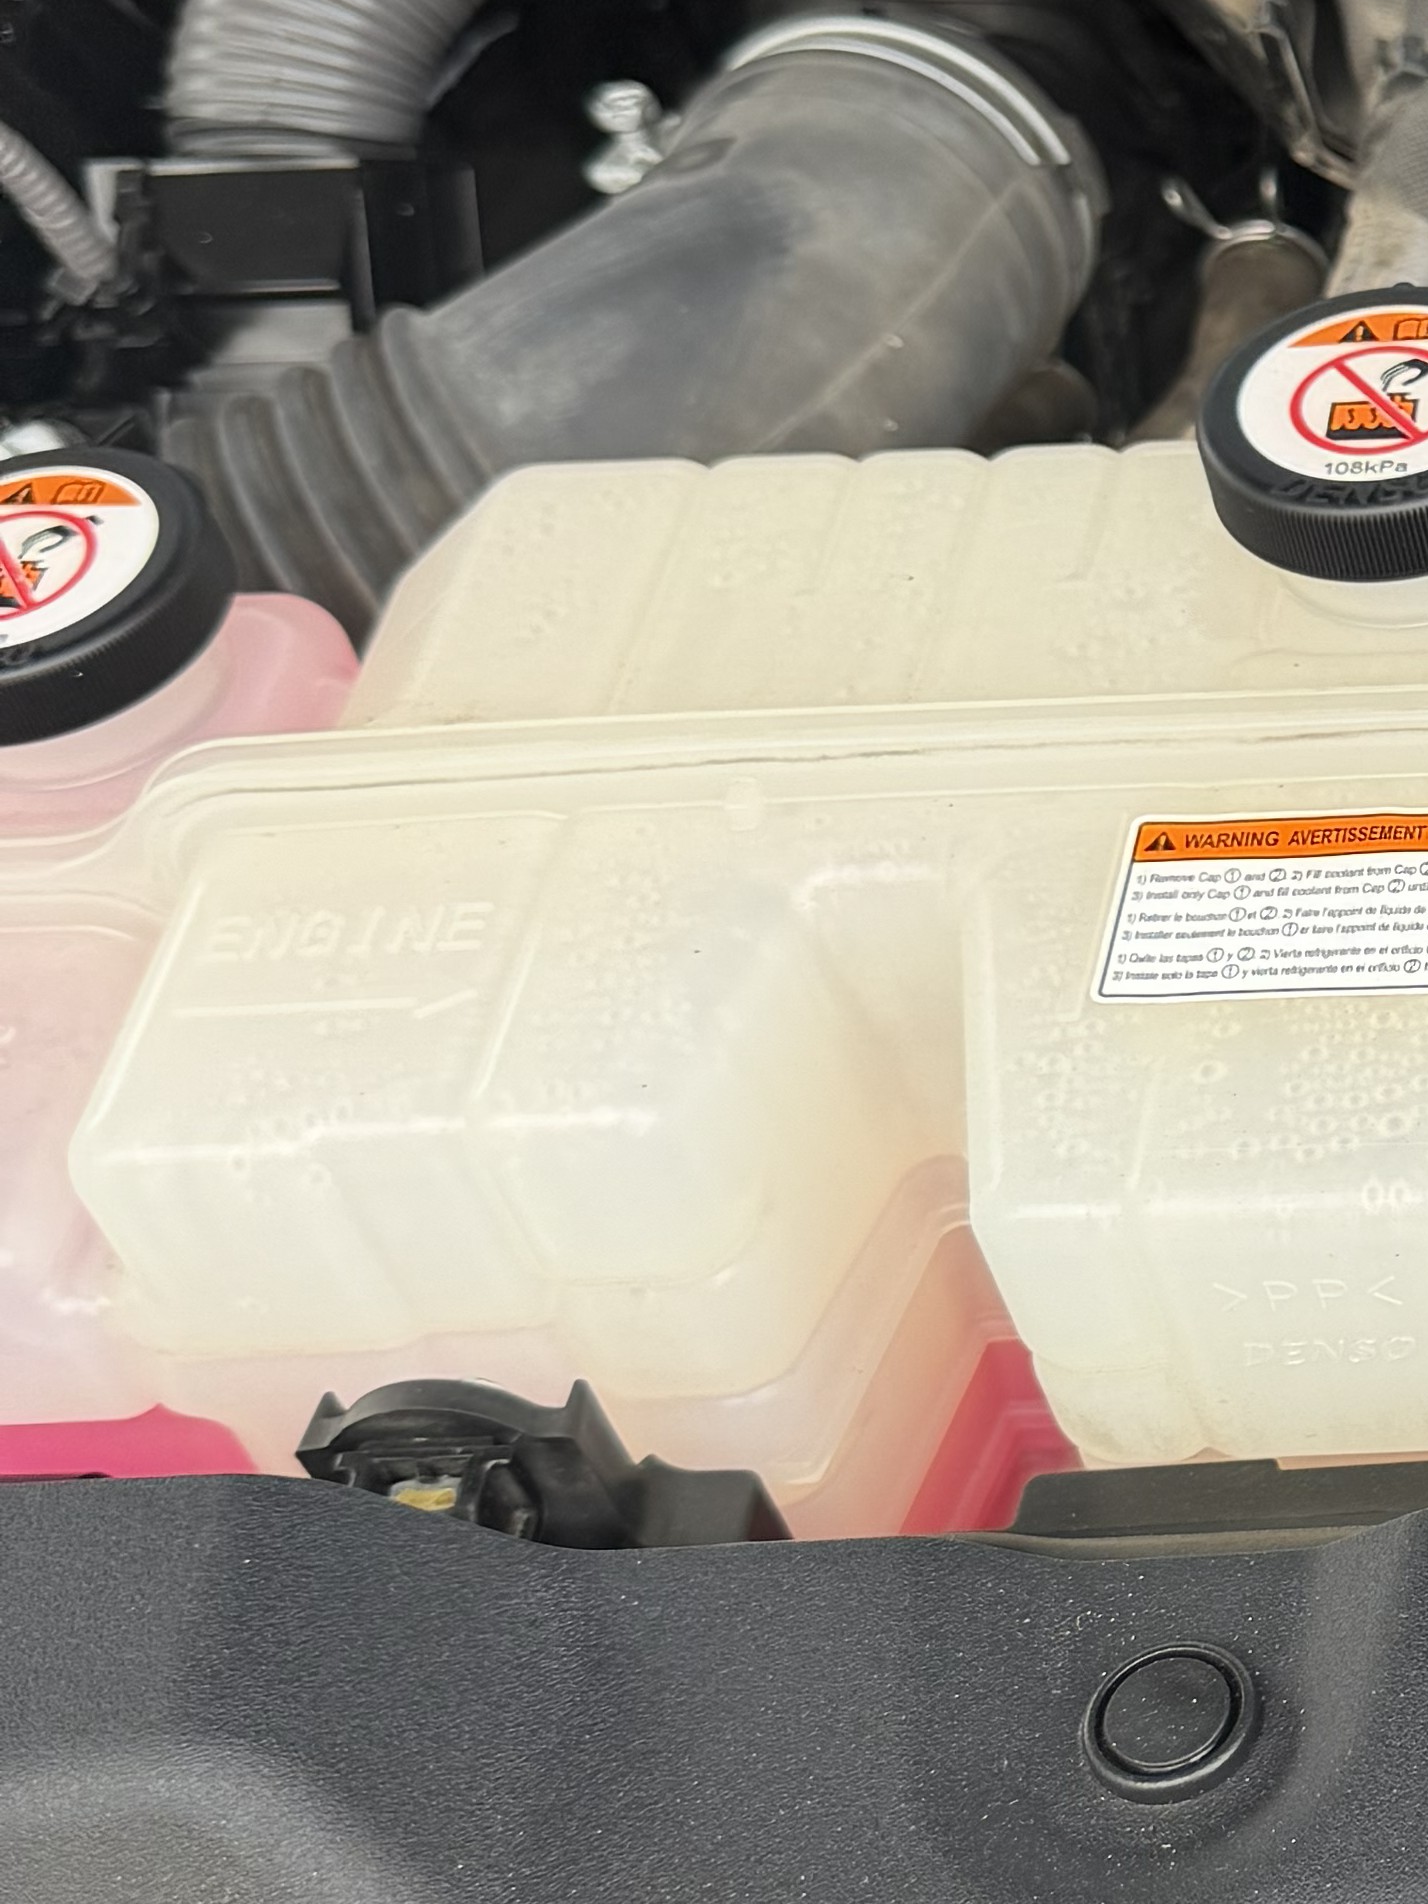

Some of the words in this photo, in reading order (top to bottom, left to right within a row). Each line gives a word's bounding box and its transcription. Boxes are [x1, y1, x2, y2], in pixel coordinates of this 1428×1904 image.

[1325, 460, 1408, 475] 108kPa
[1185, 831, 1279, 848] WARNING
[1288, 825, 1427, 846] AVERTISSEMENT
[197, 901, 494, 962] ENGINE
[1244, 1336, 1416, 1366] DENSO
